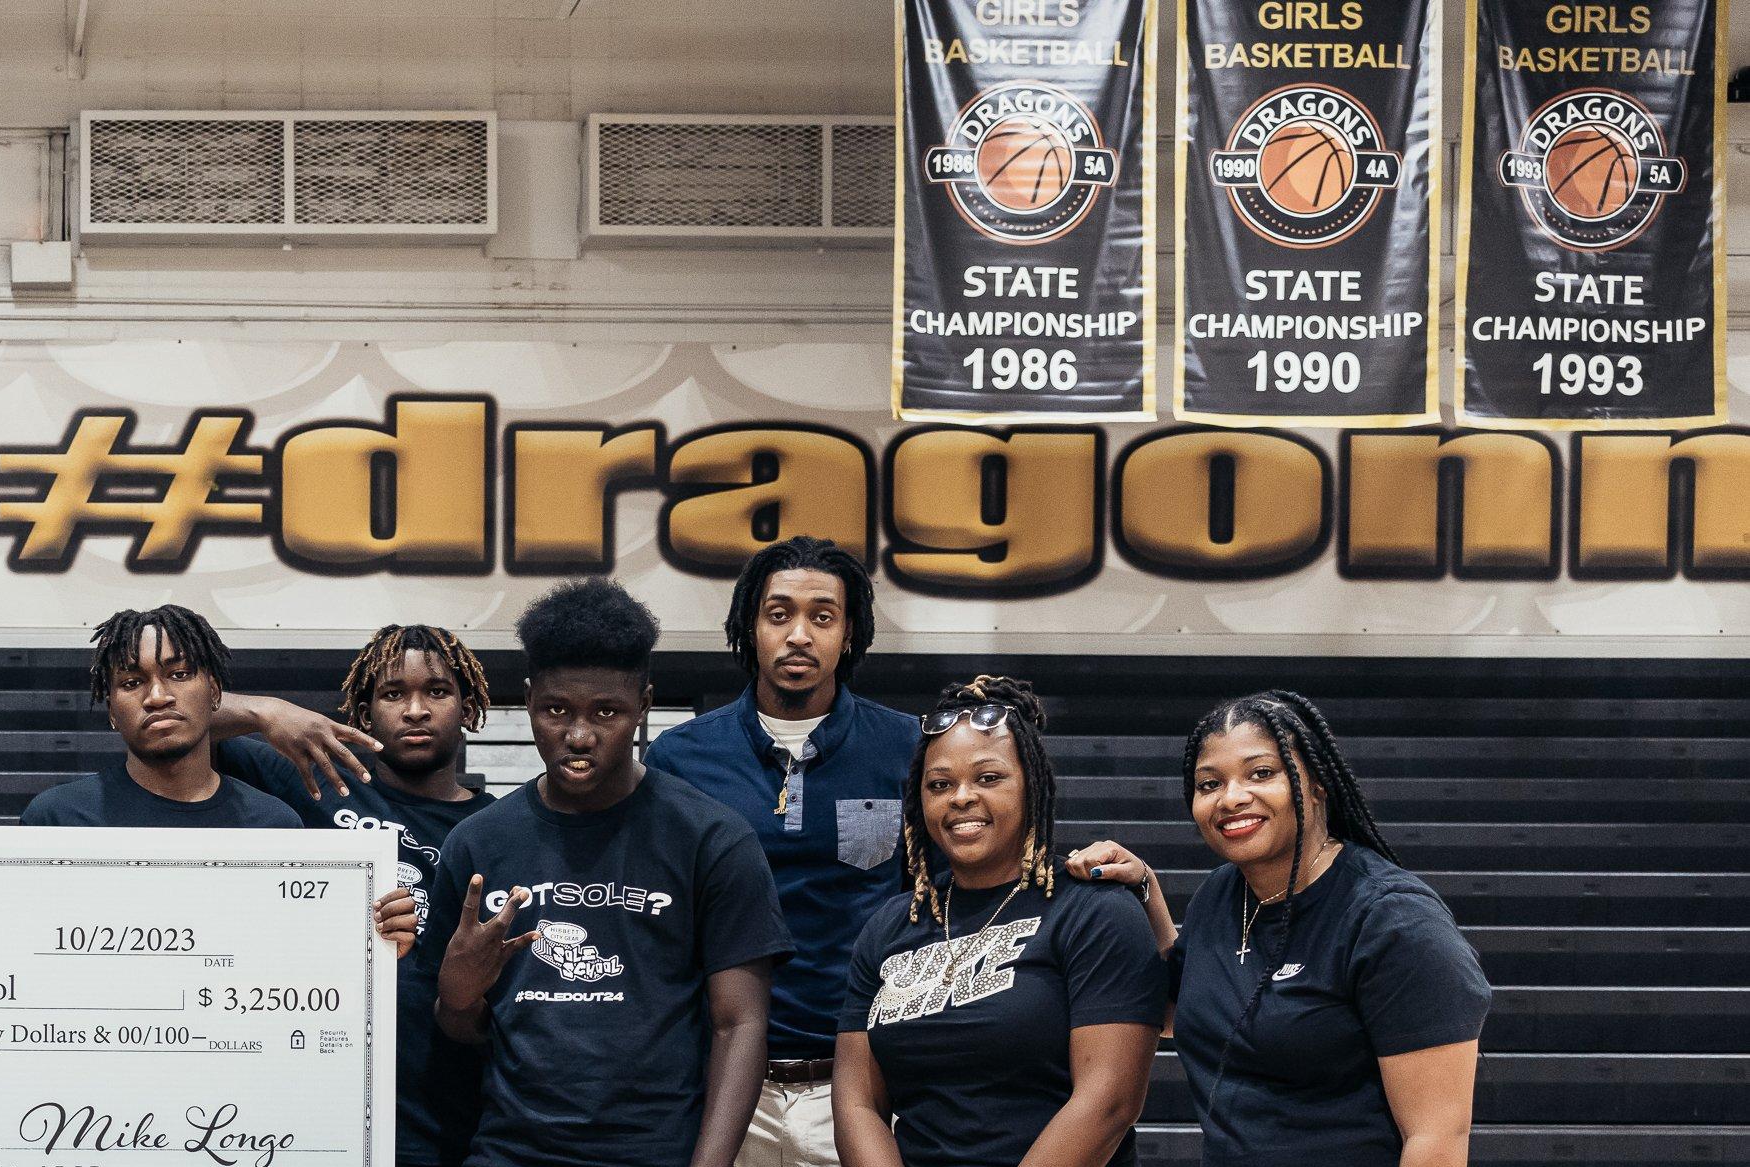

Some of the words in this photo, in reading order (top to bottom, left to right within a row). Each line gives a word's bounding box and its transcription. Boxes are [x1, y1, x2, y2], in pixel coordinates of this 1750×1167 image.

[976, 0, 1080, 28] GIRLS
[1258, 1, 1364, 30] GIRLS
[1546, 4, 1651, 34] GIRLS
[925, 38, 1128, 67] BASKETBALL
[1204, 42, 1411, 70] BASKETBALL
[1499, 45, 1696, 76] BASKETBALL
[960, 90, 1090, 143] DRAGONS
[1241, 93, 1371, 147] DRAGONS
[1529, 98, 1655, 152] DRAGONS
[932, 154, 974, 174] 1986
[1084, 158, 1107, 176] 5A
[1215, 158, 1256, 178] 1990
[1365, 159, 1390, 178] 4A
[1507, 158, 1542, 180] 1993
[1649, 165, 1671, 184] 5A
[962, 265, 1079, 302] STATE
[1246, 269, 1361, 302] STATE
[1534, 273, 1645, 306] STATE
[910, 309, 1138, 338] CHAMPIONSHIP
[1188, 310, 1422, 343] CHAMPIONSHIP
[1472, 314, 1707, 343] CHAMPIONSHIP
[962, 346, 1079, 392] 1986
[1246, 350, 1362, 394] 1990
[1532, 351, 1645, 397] 1993
[278, 880, 329, 899] 1027
[55, 926, 196, 952] 10/2/2023
[550, 926, 580, 935] HIBBETT
[204, 958, 234, 968] DATE
[553, 945, 597, 964] SOLE
[562, 957, 624, 981] SCHOOL
[867, 916, 1042, 1031] NIKE
[198, 987, 212, 1008] $
[223, 987, 340, 1014] 3,250.00
[514, 991, 624, 1003] #SOLEDOUT24
[11, 1023, 86, 1045] Dollars
[93, 1025, 111, 1045] &
[208, 1040, 263, 1051] DOLLARS
[319, 1029, 347, 1037] Security
[18, 1101, 170, 1156] Mike
